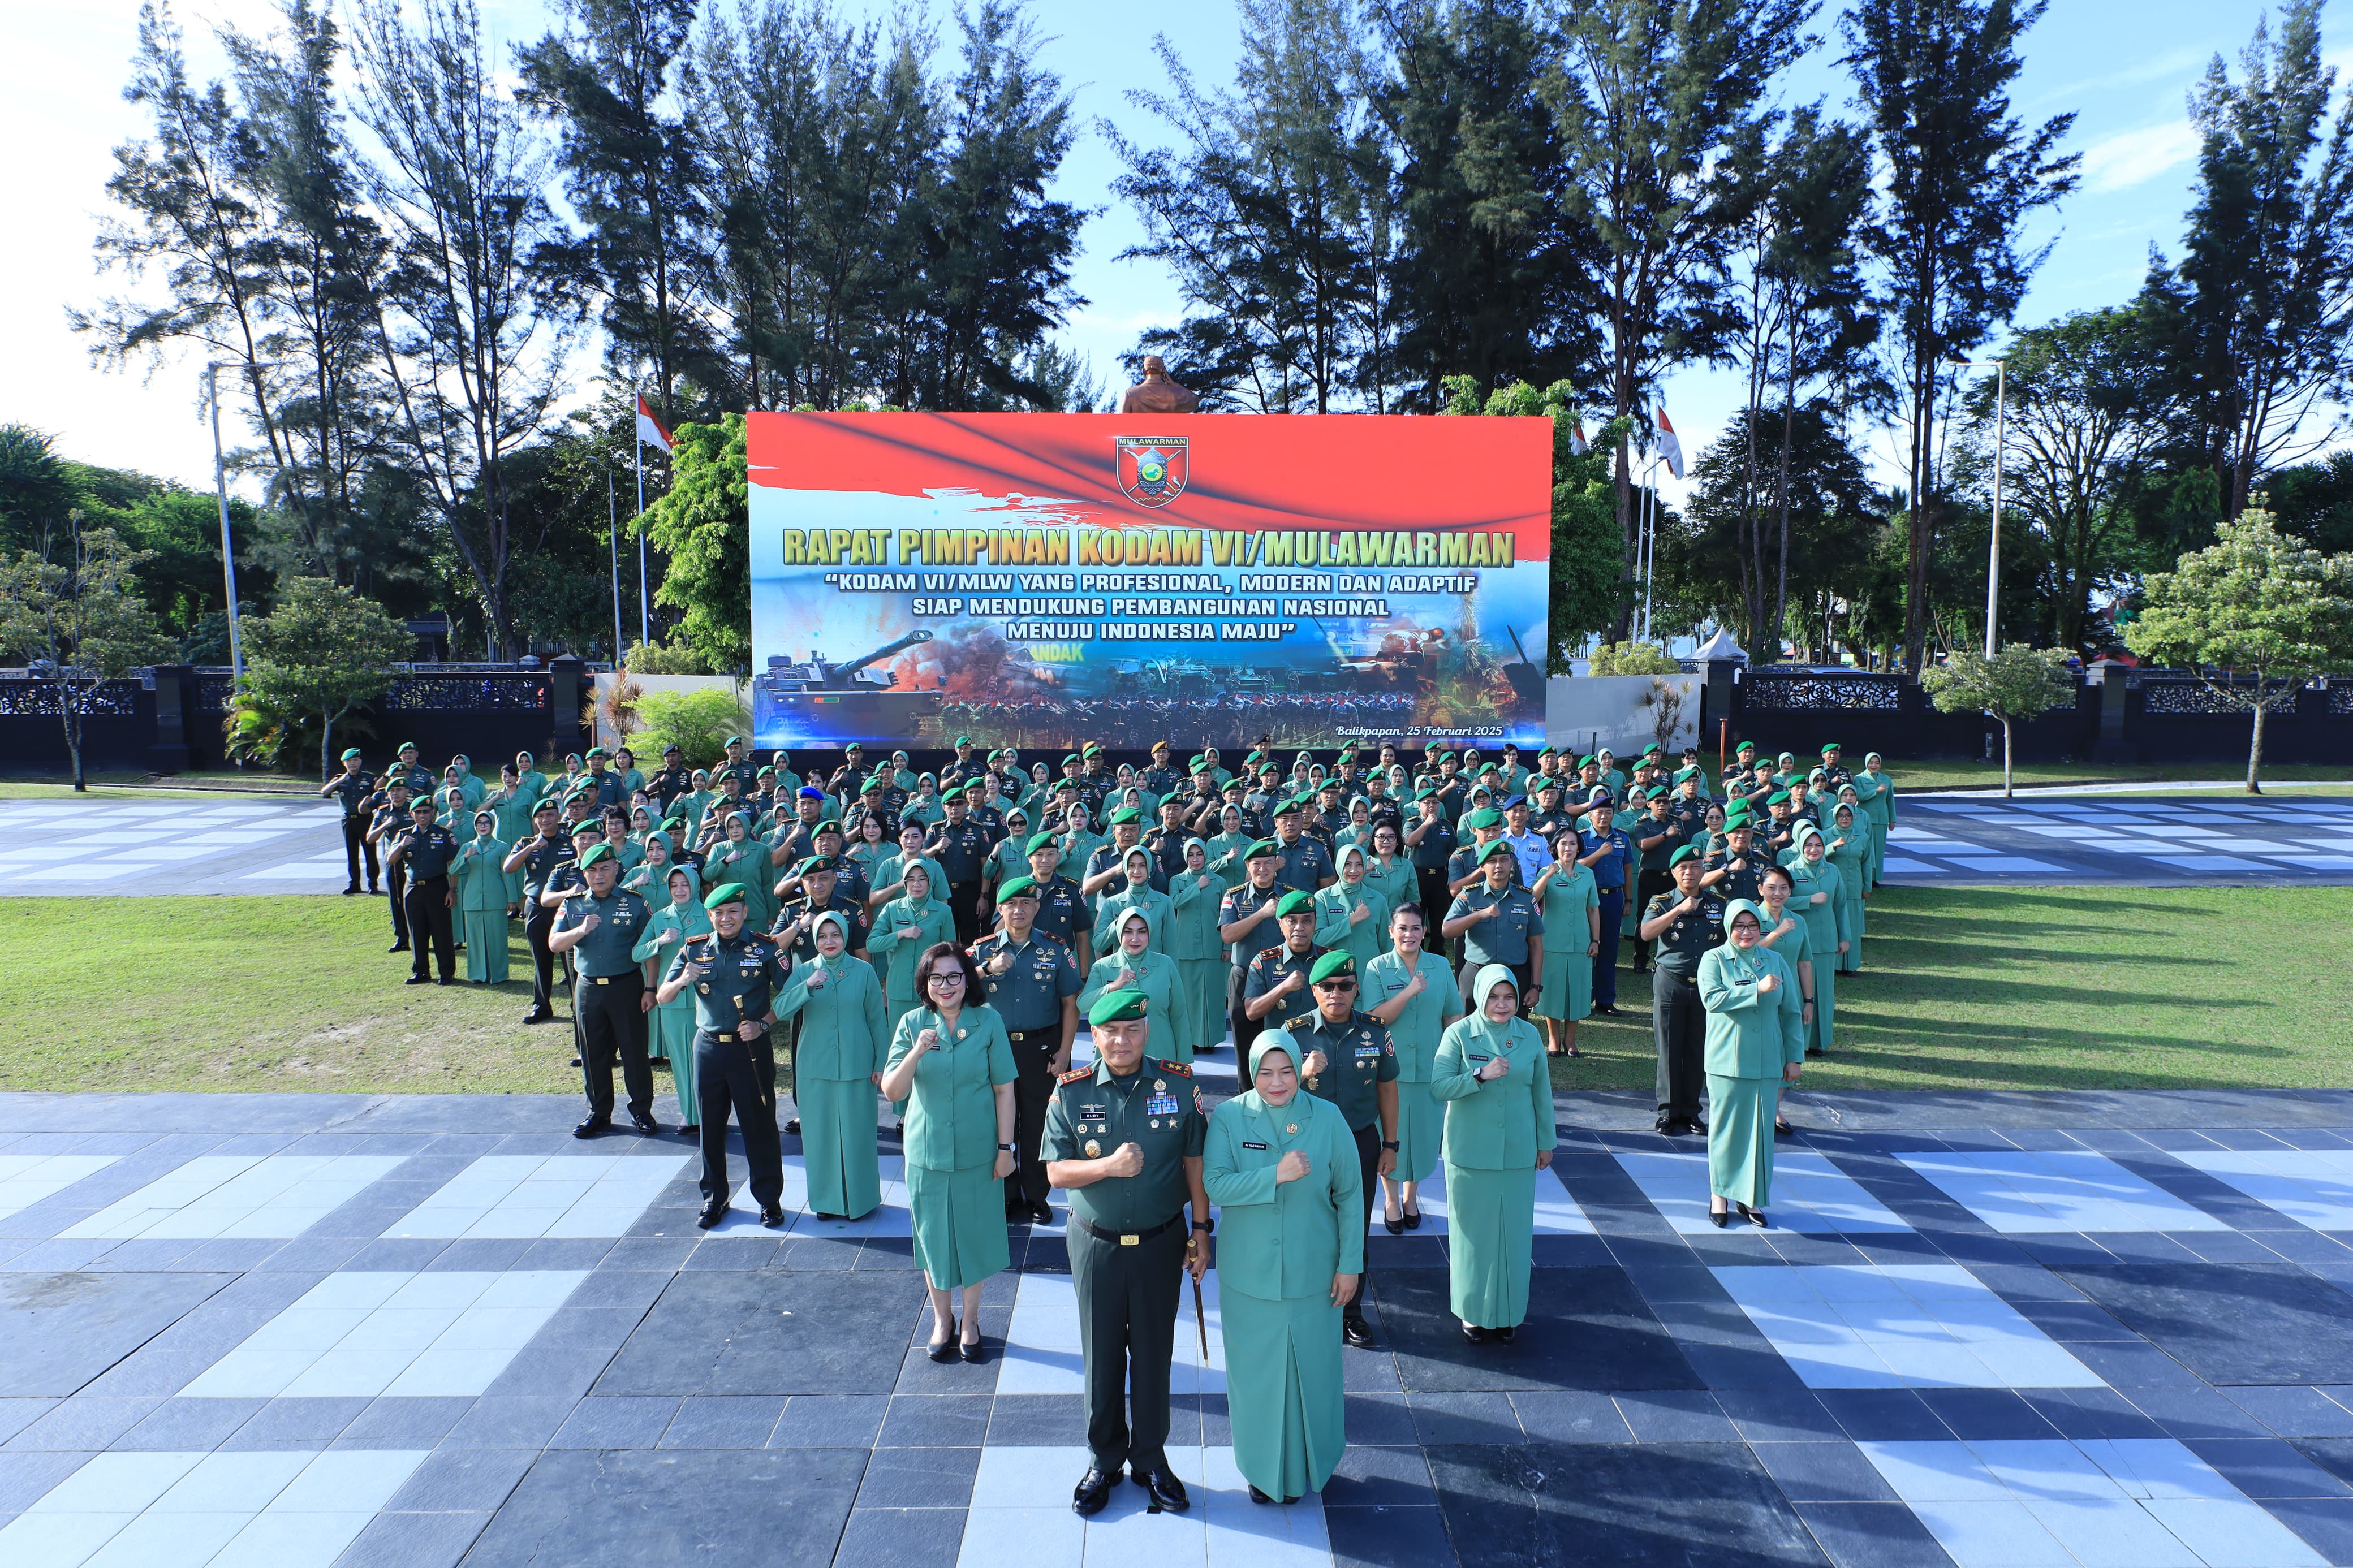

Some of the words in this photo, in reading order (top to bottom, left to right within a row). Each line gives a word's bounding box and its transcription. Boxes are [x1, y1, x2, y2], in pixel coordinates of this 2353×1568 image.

[783, 529, 892, 565] RAPAT
[899, 529, 1070, 566] PIMPINAN
[1078, 529, 1203, 567] KODAM
[1209, 530, 1515, 568] VI/MULAWARMAN
[923, 573, 1013, 591] VI/MLW
[1018, 574, 1074, 591] YANG
[1082, 574, 1231, 594] PROFESIONAL,
[1240, 574, 1331, 592] MODERN
[1339, 575, 1385, 592] DAN
[1389, 575, 1476, 593] ADAPTIF
[912, 598, 962, 615] SIAP
[969, 598, 1105, 615] MENDUKUNG
[1112, 599, 1276, 616] PEMBANGUNAN
[1283, 599, 1389, 616] NASIONAL
[1007, 623, 1093, 640] MENUJU
[1101, 623, 1215, 640] INDONESIA
[1335, 726, 1404, 737] Balikpapan,
[1407, 726, 1421, 735] 25
[1423, 726, 1472, 736] Februari
[1475, 726, 1503, 735] 2025
